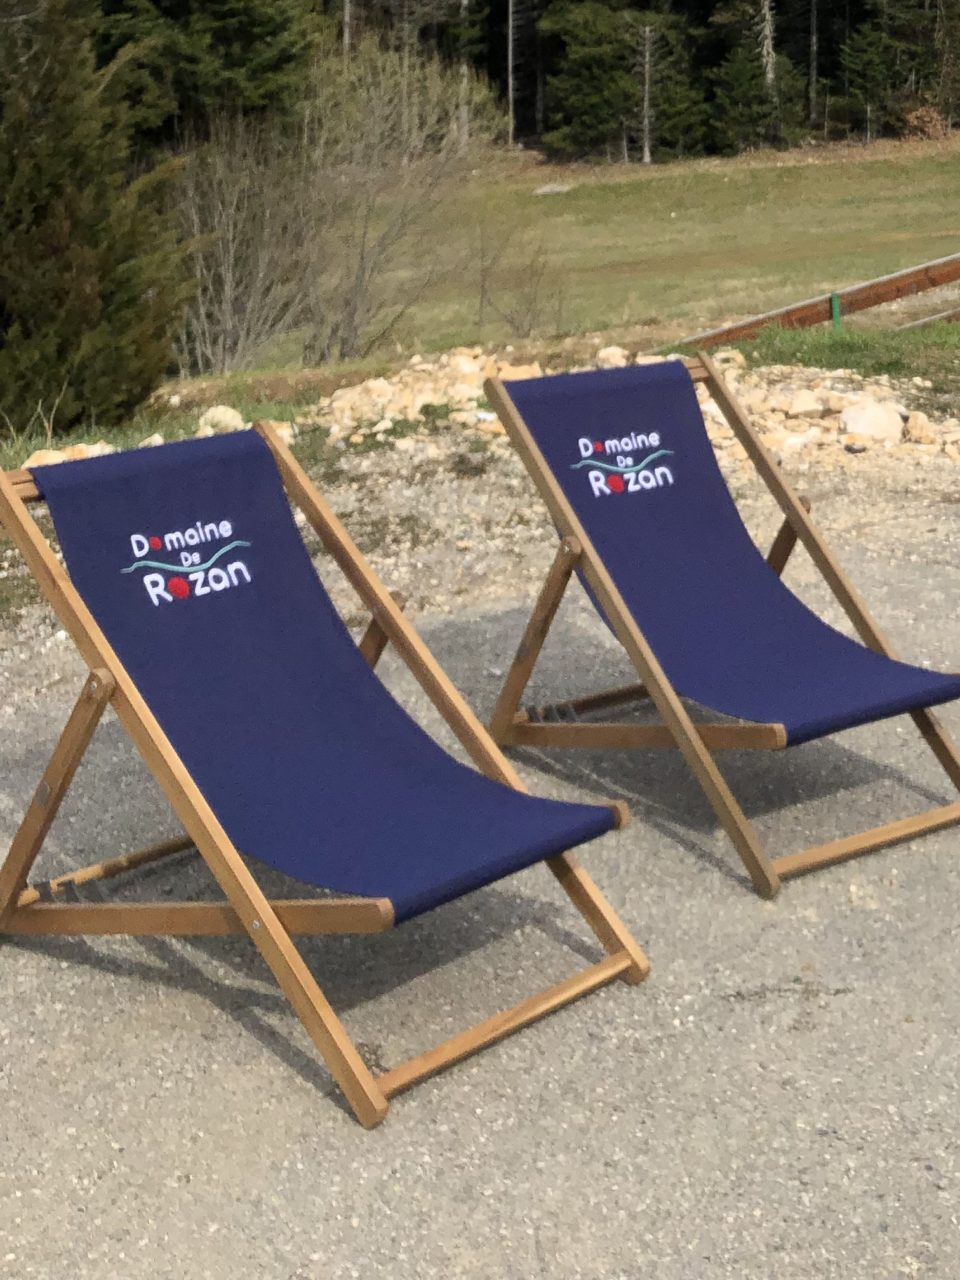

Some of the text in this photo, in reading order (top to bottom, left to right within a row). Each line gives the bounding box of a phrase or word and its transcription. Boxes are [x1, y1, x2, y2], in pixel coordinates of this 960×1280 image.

[578, 431, 661, 458] Domaine
[616, 455, 634, 468] De
[588, 466, 674, 498] Rozan
[130, 520, 233, 558] Domaine
[180, 551, 201, 567] De
[143, 561, 251, 607] Rozan
